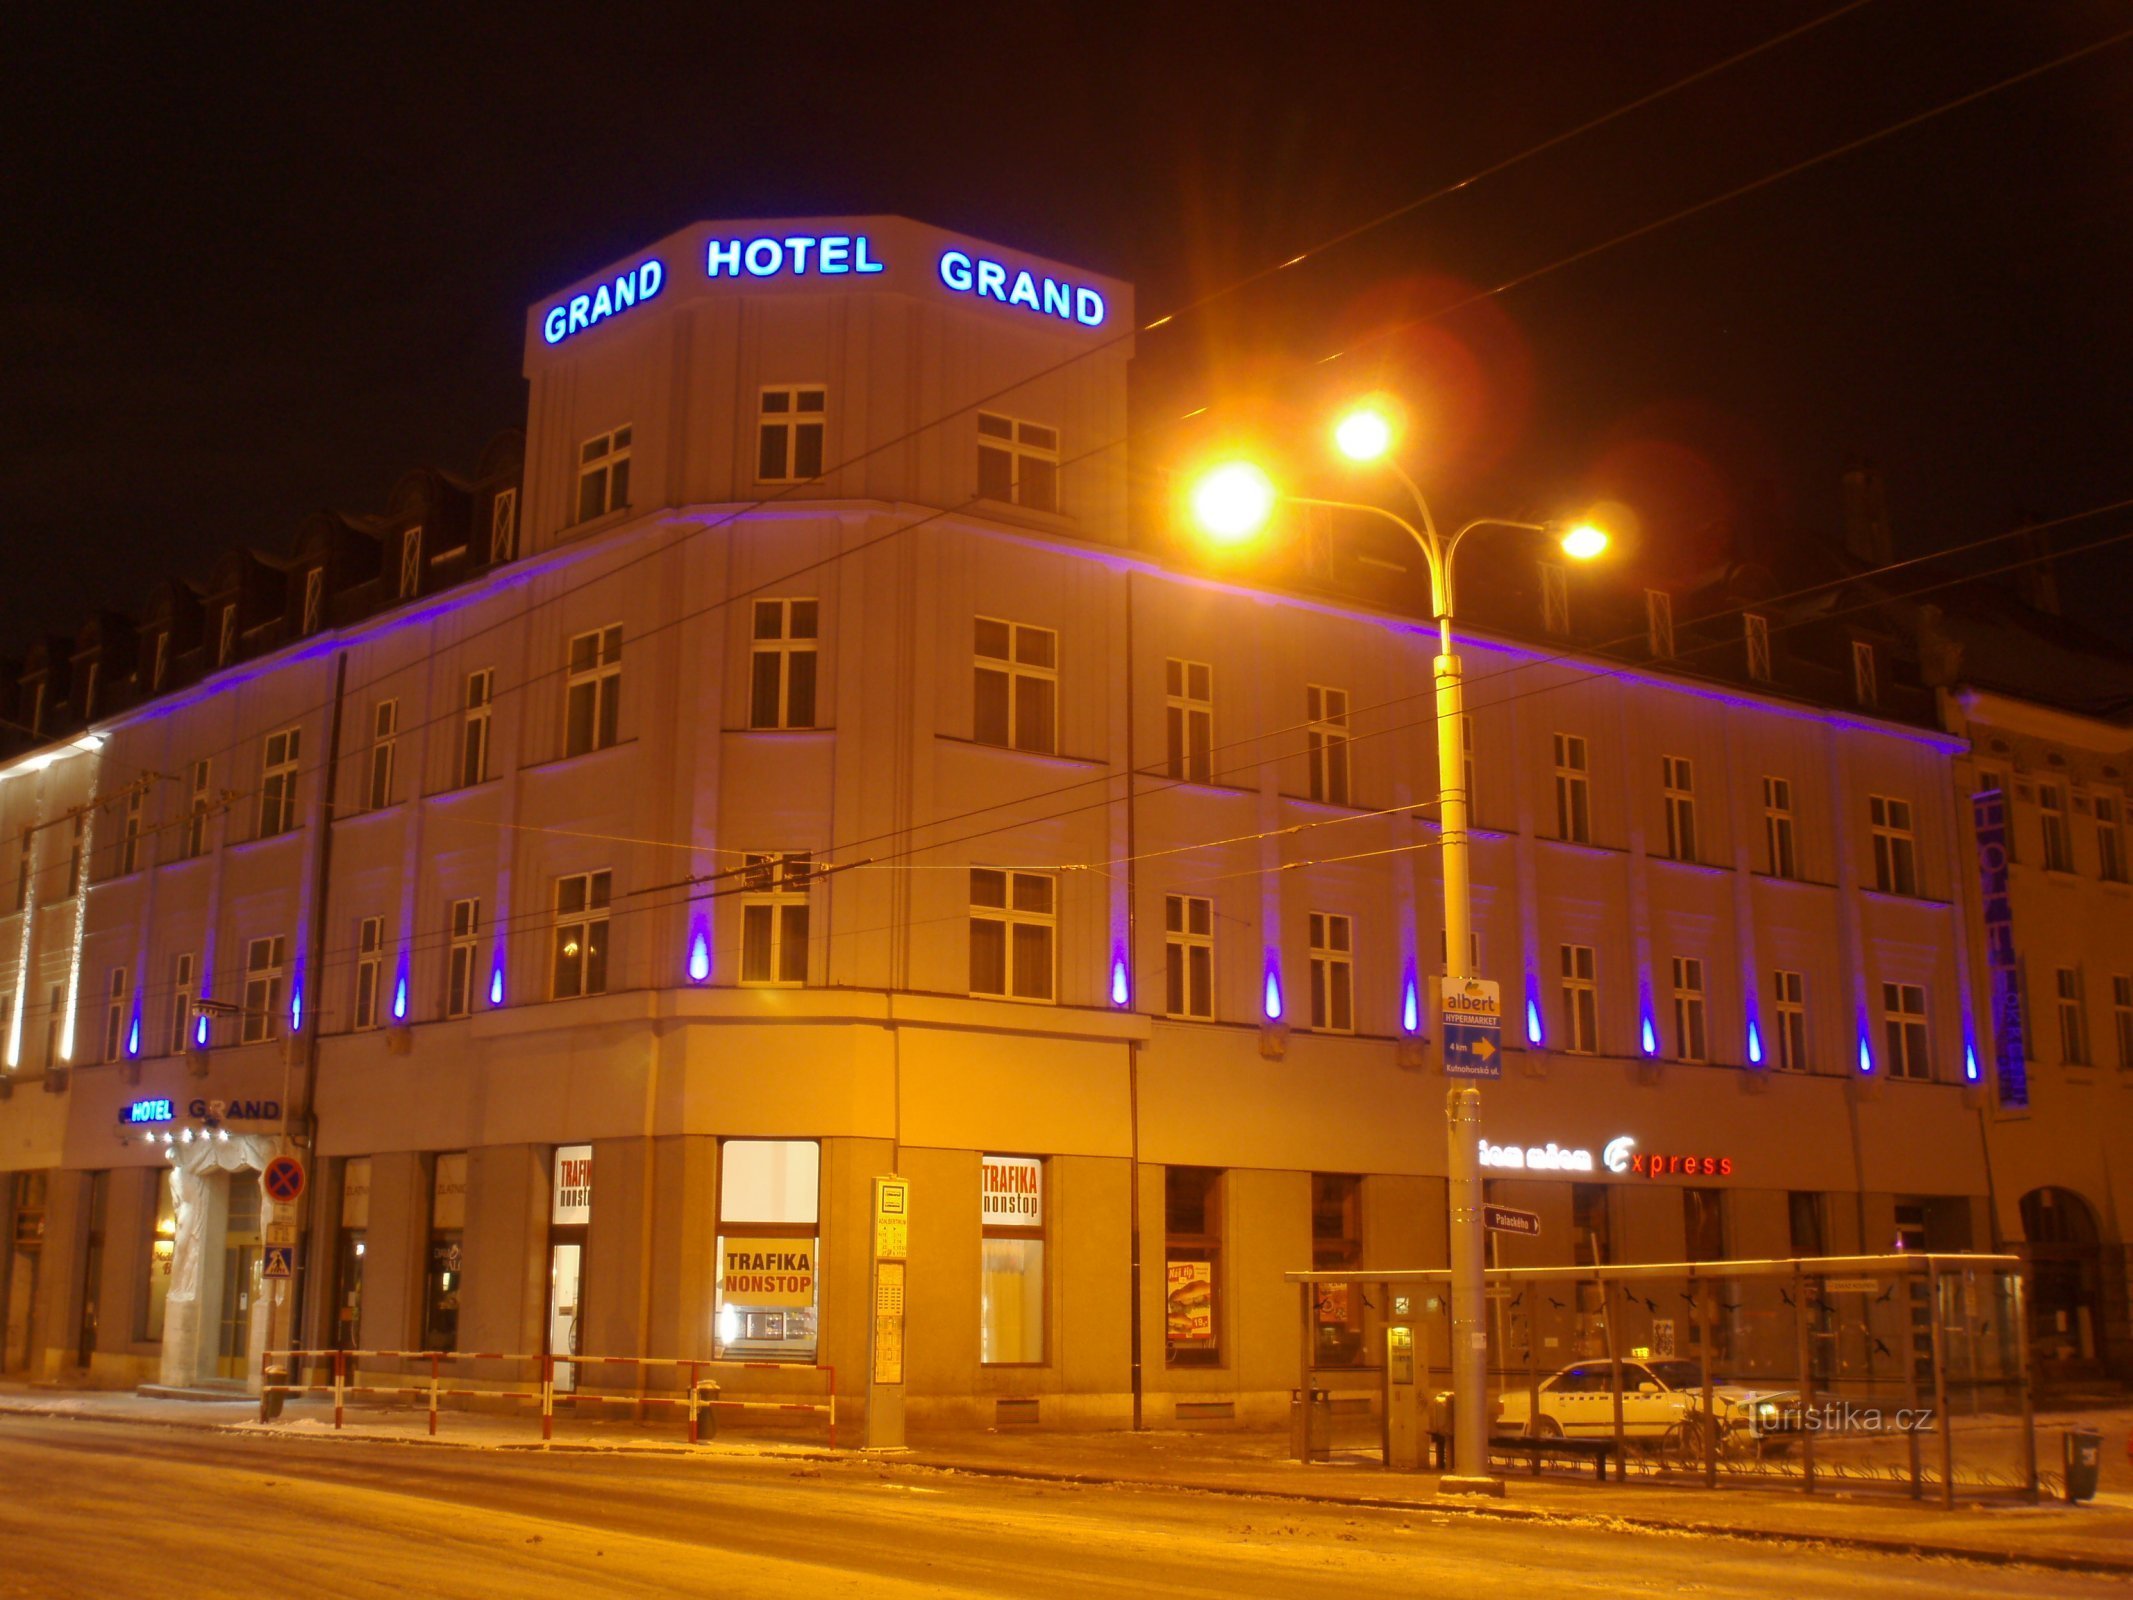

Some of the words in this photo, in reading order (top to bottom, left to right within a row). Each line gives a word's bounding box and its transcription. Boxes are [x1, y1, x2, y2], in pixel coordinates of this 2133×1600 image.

[707, 236, 884, 277] HOTEL
[940, 251, 1104, 326] GRAND
[544, 260, 662, 344] GRAND
[1448, 993, 1495, 1012] albert
[1445, 1013, 1497, 1026] HYPERMARKET
[1449, 1042, 1454, 1050] 4
[1455, 1043, 1468, 1052] km
[131, 1099, 172, 1122] HOTEL
[188, 1099, 280, 1120] GRAND
[1603, 1136, 1732, 1179] Express
[982, 1164, 1038, 1194] TRAFIKA
[983, 1193, 1038, 1218] nonstop
[1495, 1212, 1529, 1231] Palackého
[726, 1252, 810, 1271] TRAFIKA
[725, 1275, 812, 1293] NONSTOP
